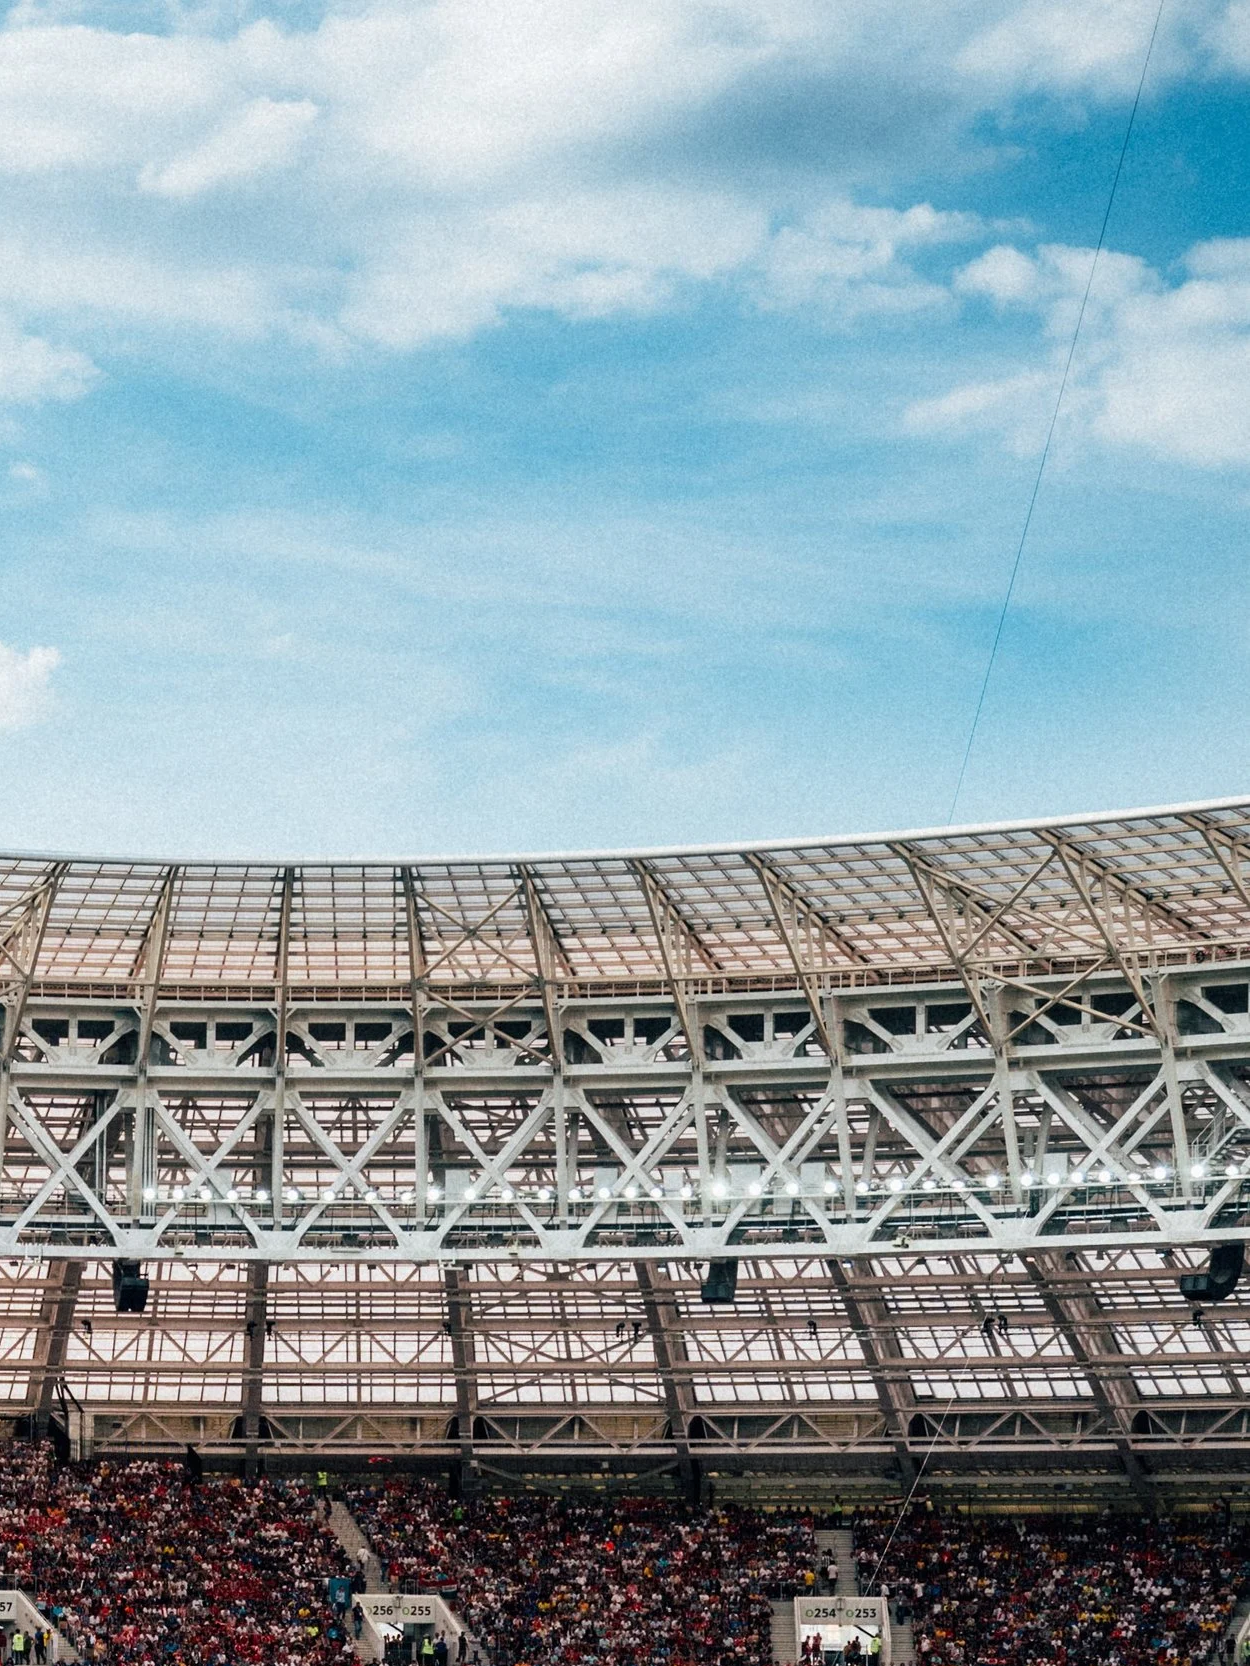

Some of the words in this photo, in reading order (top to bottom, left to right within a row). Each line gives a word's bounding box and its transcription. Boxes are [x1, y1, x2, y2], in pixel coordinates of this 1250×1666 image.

[372, 1606, 393, 1616] 256
[410, 1606, 431, 1616] 255
[814, 1608, 836, 1618] 254
[854, 1608, 876, 1618] 253
